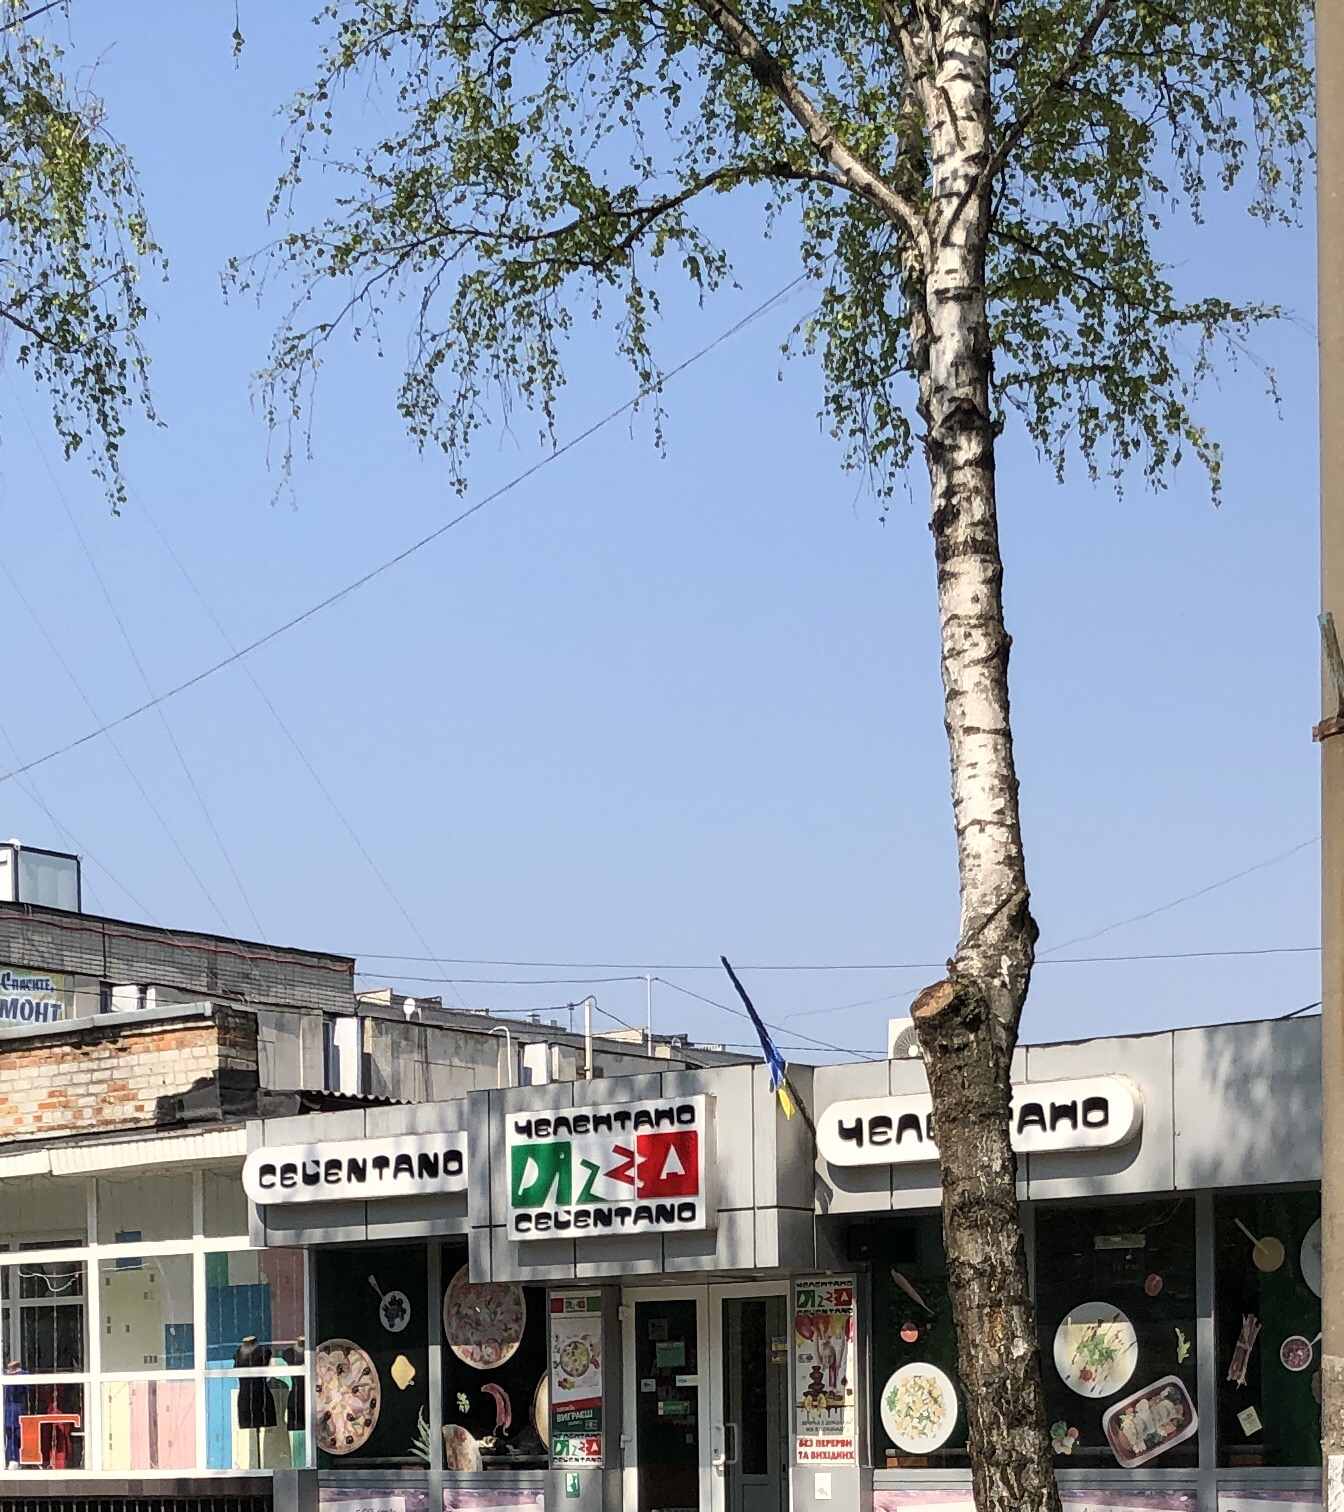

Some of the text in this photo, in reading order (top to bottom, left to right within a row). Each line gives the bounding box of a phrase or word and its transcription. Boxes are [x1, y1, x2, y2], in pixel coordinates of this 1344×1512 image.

[514, 1104, 695, 1139] ЧЕЛЕНТАНО
[837, 1096, 1109, 1148] ЧЕЛАНО
[258, 1148, 464, 1190] CELENTANO
[514, 1201, 697, 1233] CELENTANO
[798, 1451, 809, 1460] ТА
